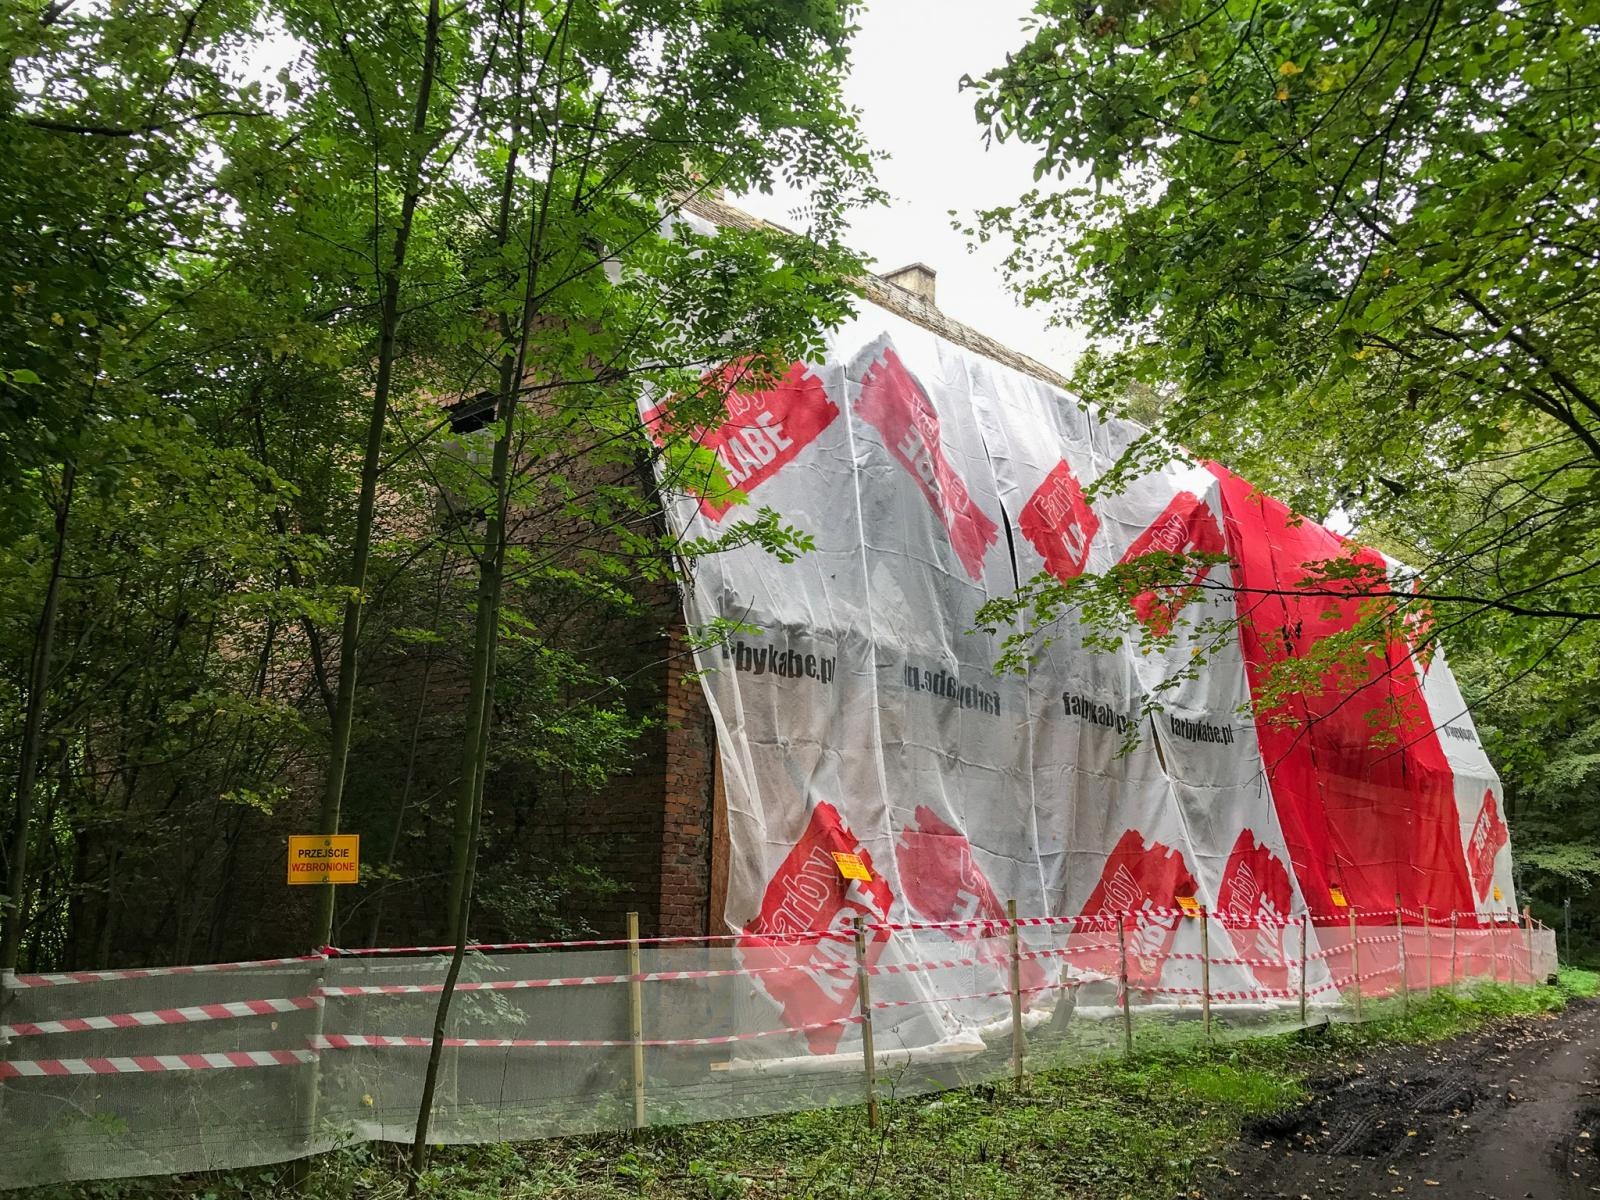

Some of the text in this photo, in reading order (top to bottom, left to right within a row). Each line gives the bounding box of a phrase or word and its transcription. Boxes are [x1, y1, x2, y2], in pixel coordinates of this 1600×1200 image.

[1032, 476, 1075, 530] Farb
[298, 847, 349, 858] PRZEJŚCIE
[291, 862, 355, 872] WZBRONIONE
